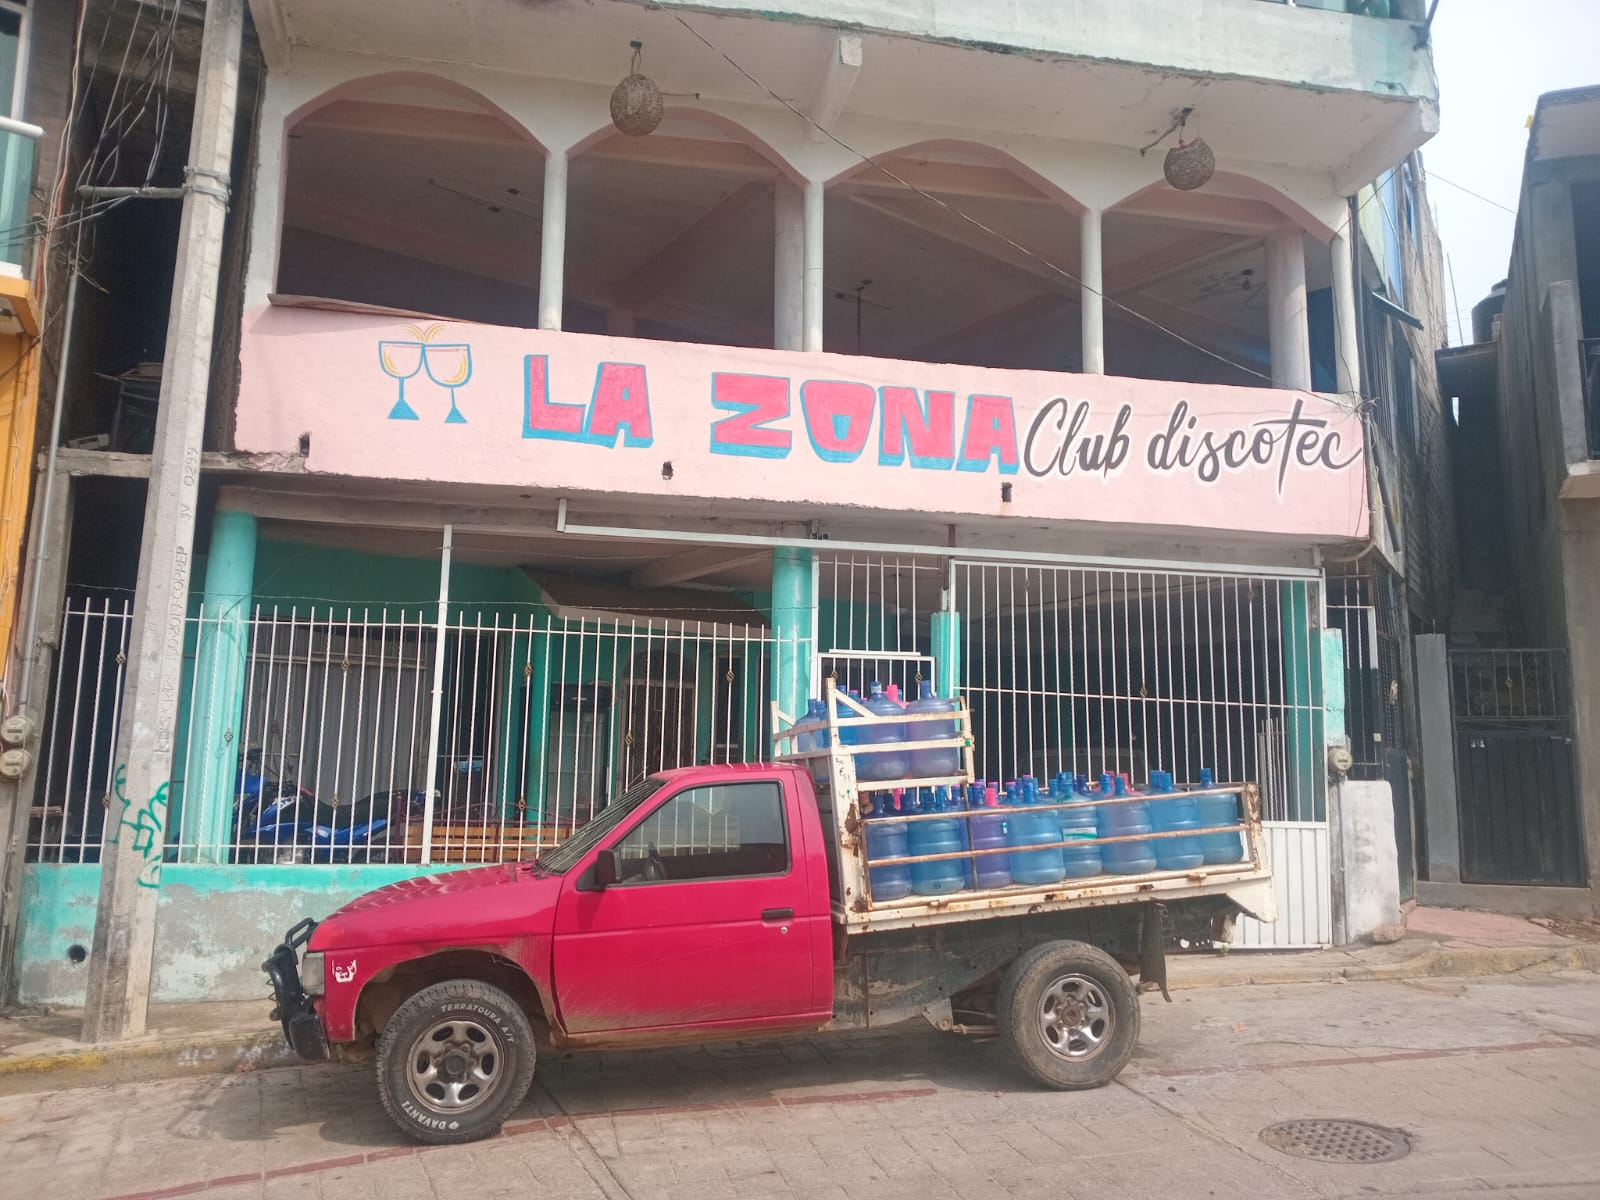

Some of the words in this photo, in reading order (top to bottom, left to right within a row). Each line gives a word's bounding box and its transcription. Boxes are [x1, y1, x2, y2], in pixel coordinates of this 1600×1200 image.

[523, 353, 653, 449] LA
[710, 371, 1019, 474] ZONA
[1024, 396, 1133, 480] Club
[1147, 393, 1364, 498] discotec
[441, 1003, 501, 1024] TERRATOURA
[400, 1100, 447, 1130] DAVANTI
